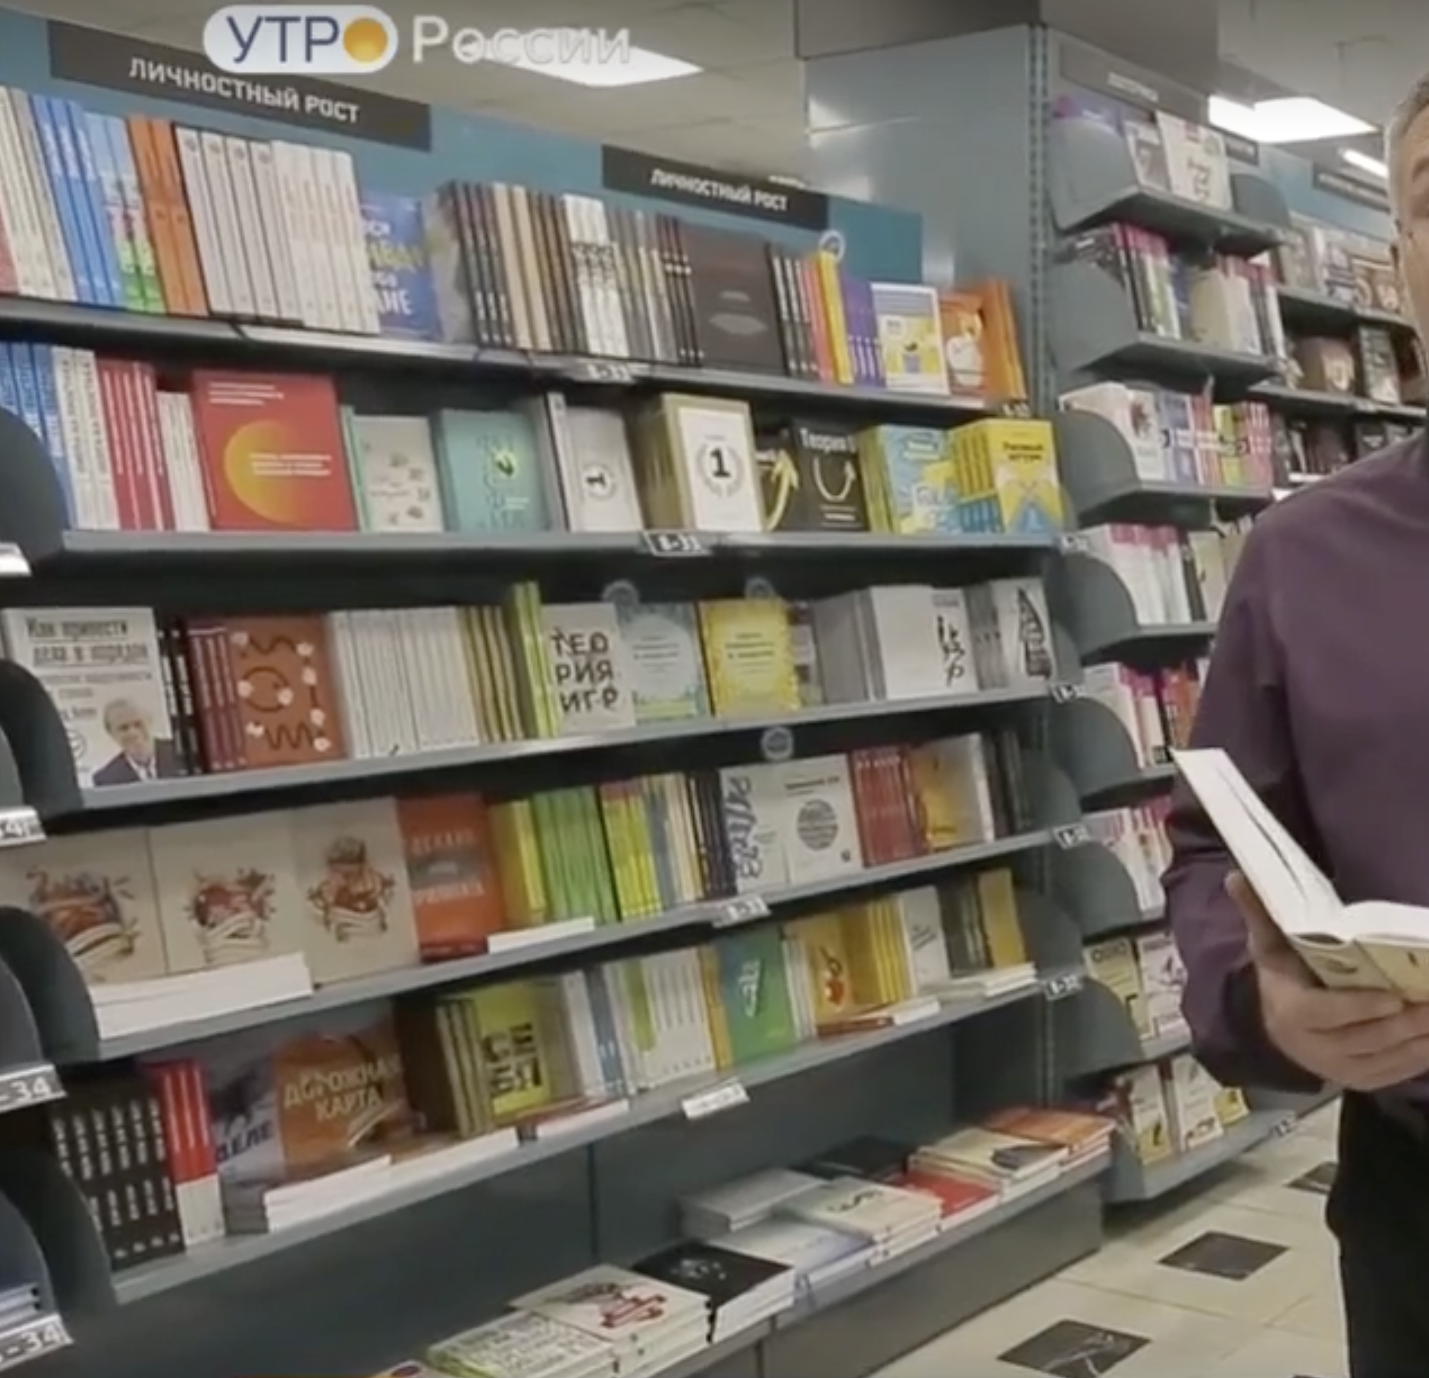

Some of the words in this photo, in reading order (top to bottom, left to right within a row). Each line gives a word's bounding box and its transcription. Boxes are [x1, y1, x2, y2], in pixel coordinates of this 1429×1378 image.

[130, 57, 300, 112] ЛИЧНОСТНЫЙ
[304, 94, 361, 123] РОСТ
[651, 168, 751, 205] ЛИЧНОСТНЫЙ
[754, 190, 788, 211] РОСТ
[711, 448, 731, 479] 1
[552, 628, 609, 657] ТЕО
[555, 659, 614, 686] РИЯ
[560, 687, 619, 714] ИГР
[314, 1086, 384, 1121] КАРТА
[0, 1325, 61, 1362] -34
